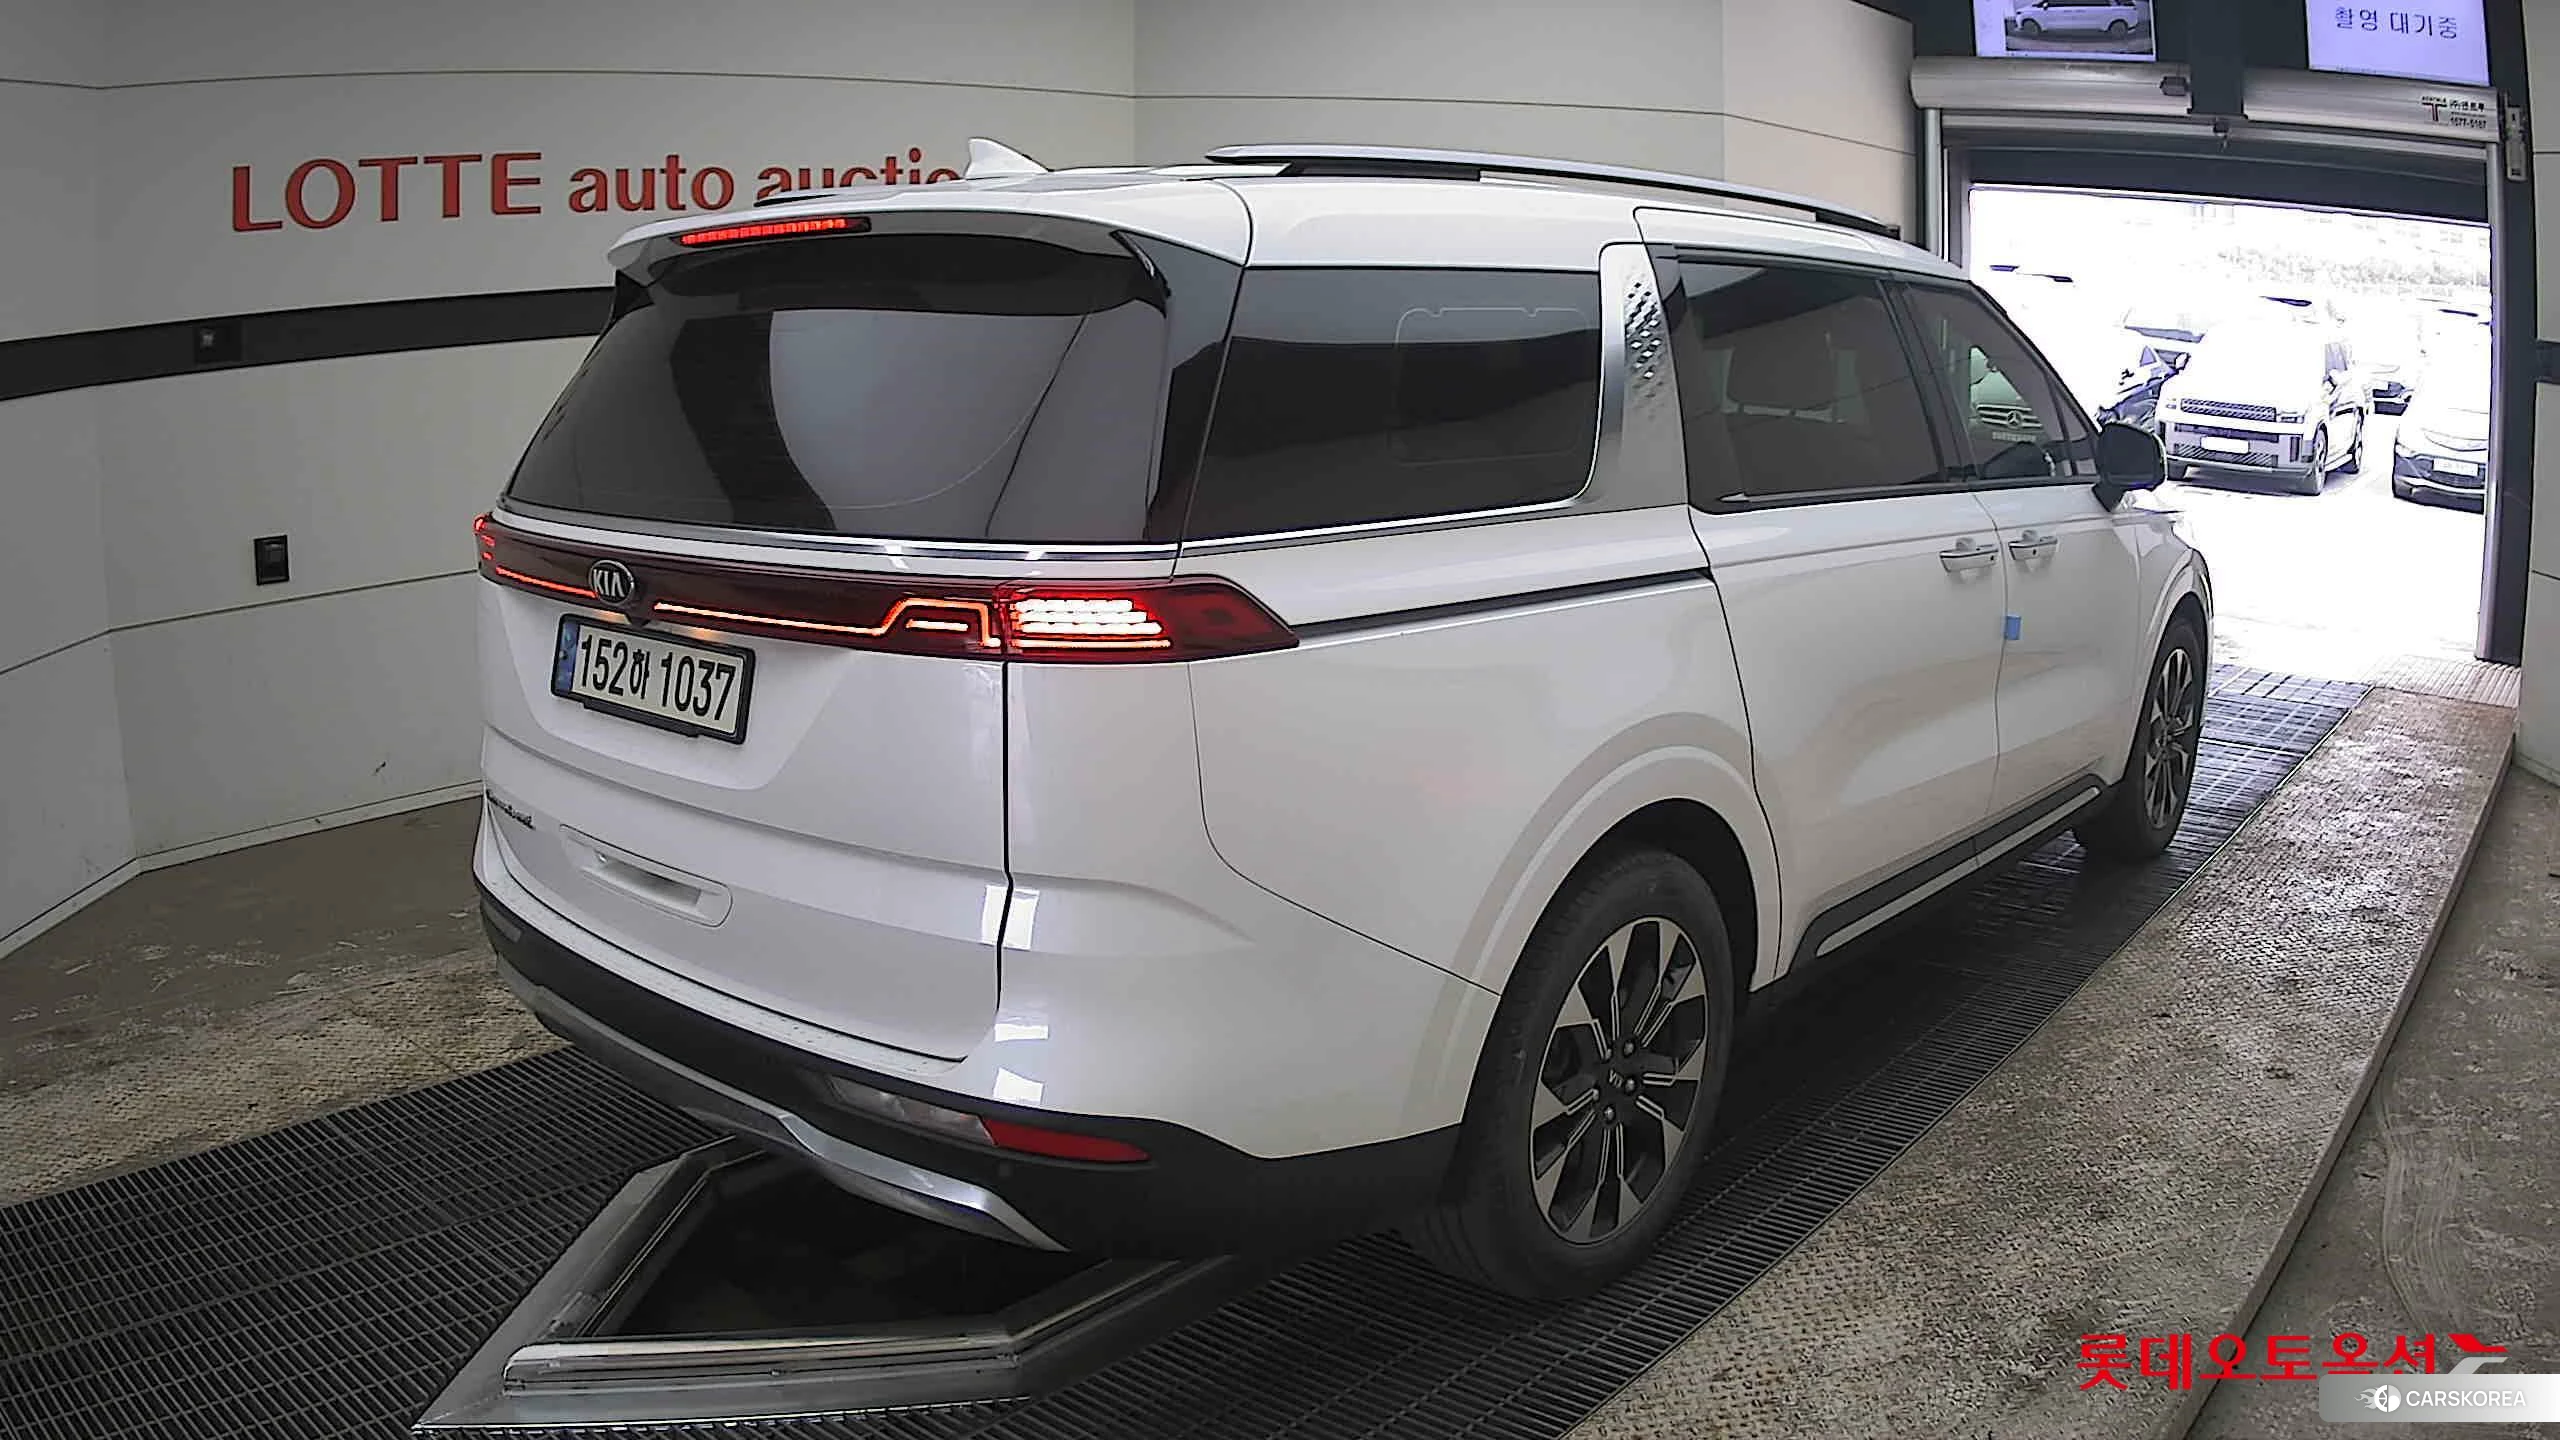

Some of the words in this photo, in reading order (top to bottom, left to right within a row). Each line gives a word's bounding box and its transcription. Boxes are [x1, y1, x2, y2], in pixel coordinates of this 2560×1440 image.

[2390, 11, 2457, 40] 대기중
[232, 152, 542, 233] LOTTE
[568, 154, 736, 213] auto
[593, 568, 626, 598] KIA
[577, 634, 650, 700] 152하
[660, 651, 737, 721] 1037
